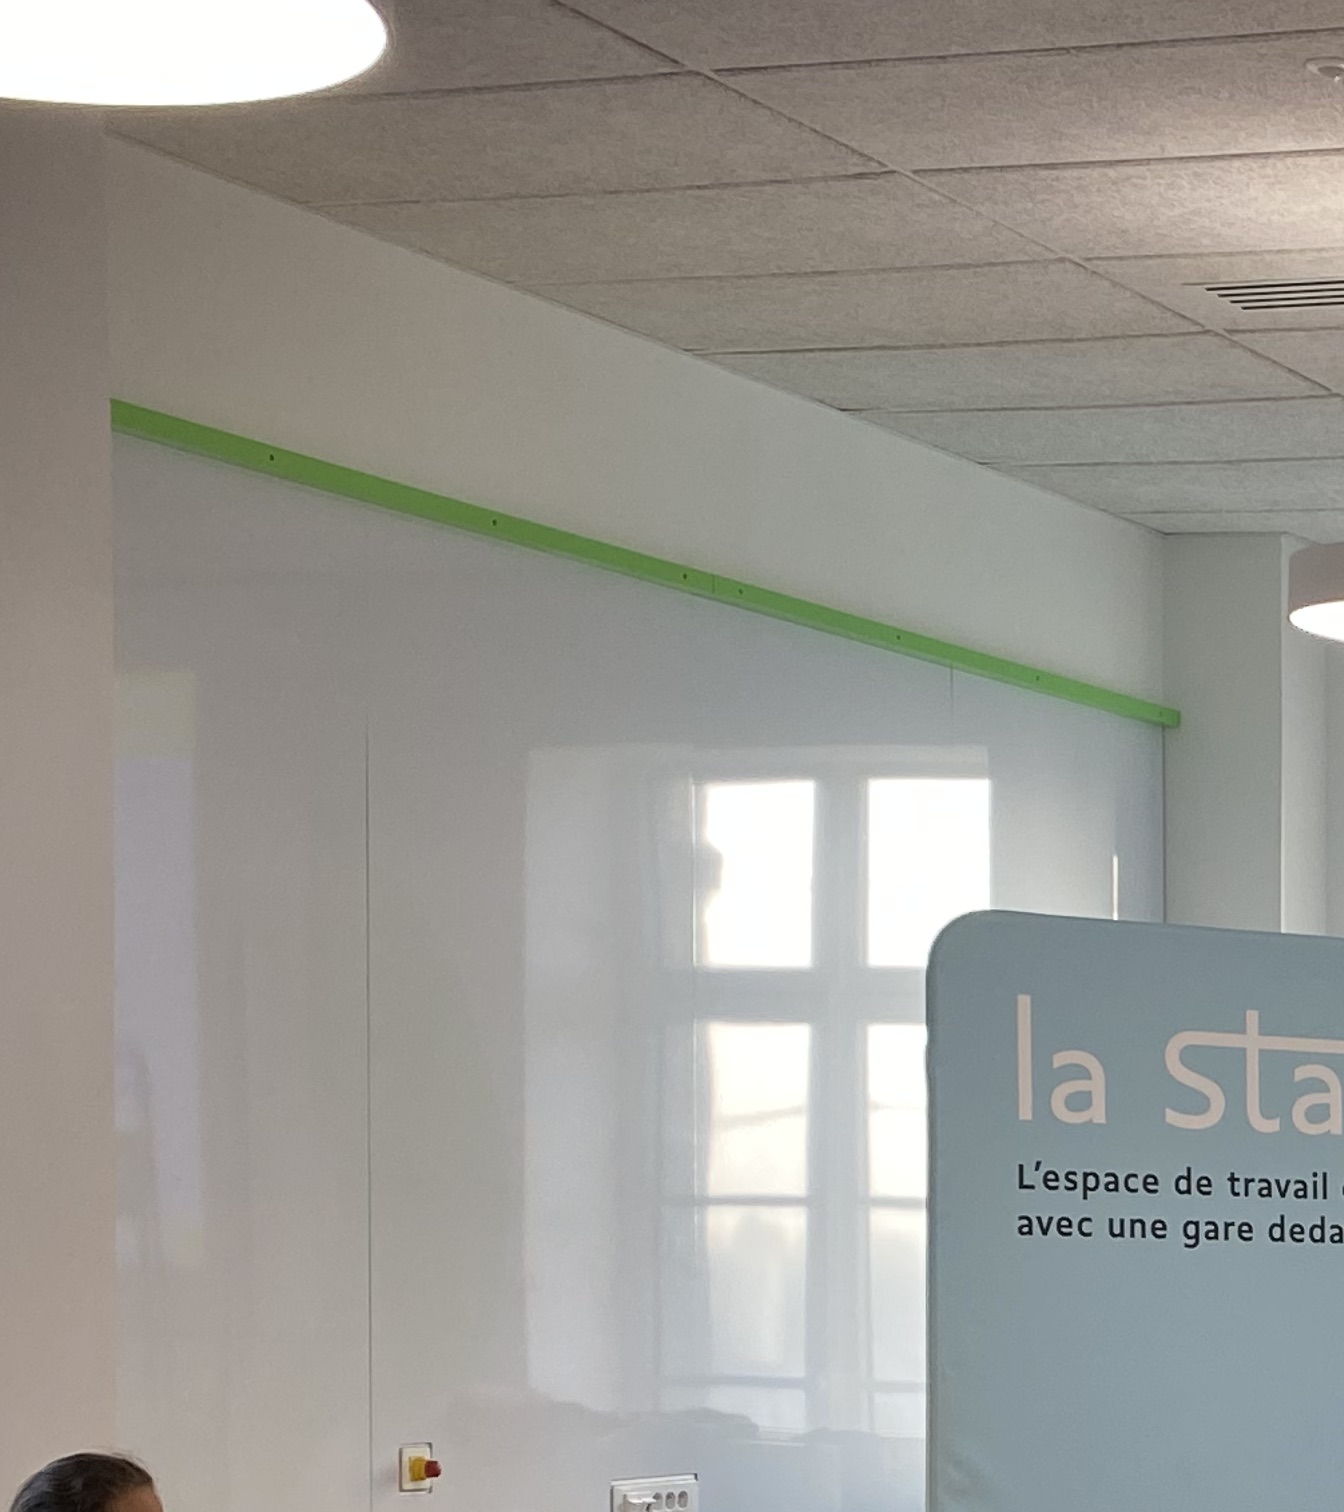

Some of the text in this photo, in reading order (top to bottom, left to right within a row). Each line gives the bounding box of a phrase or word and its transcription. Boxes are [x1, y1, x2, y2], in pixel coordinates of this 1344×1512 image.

[1016, 994, 1107, 1125] la
[1174, 1166, 1213, 1196] de
[1227, 1171, 1328, 1200] travail
[1017, 1215, 1094, 1238] avec
[1108, 1216, 1168, 1239] une
[1182, 1218, 1254, 1249] gare
